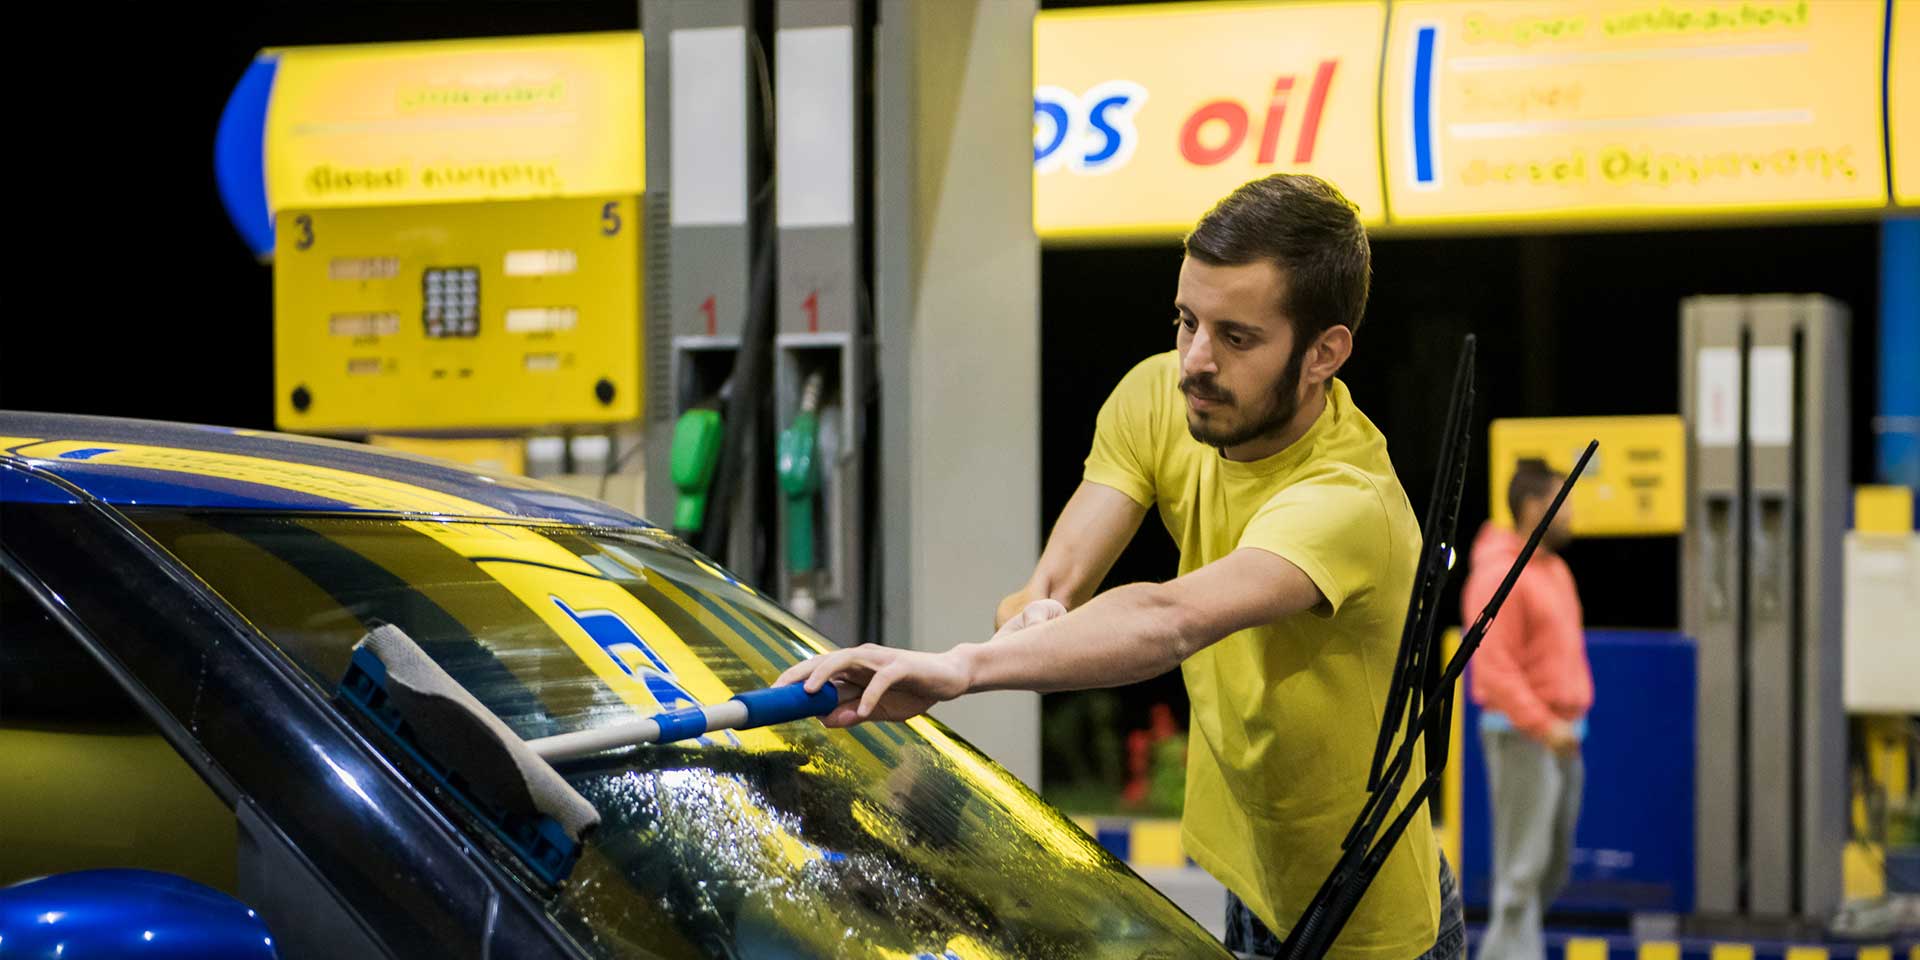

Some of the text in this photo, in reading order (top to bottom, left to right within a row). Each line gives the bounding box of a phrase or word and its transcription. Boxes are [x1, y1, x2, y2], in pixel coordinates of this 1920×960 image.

[1179, 60, 1339, 167] oil
[294, 214, 315, 250] 3
[601, 202, 622, 236] 5
[698, 295, 717, 336] 1
[801, 290, 819, 333] 1
